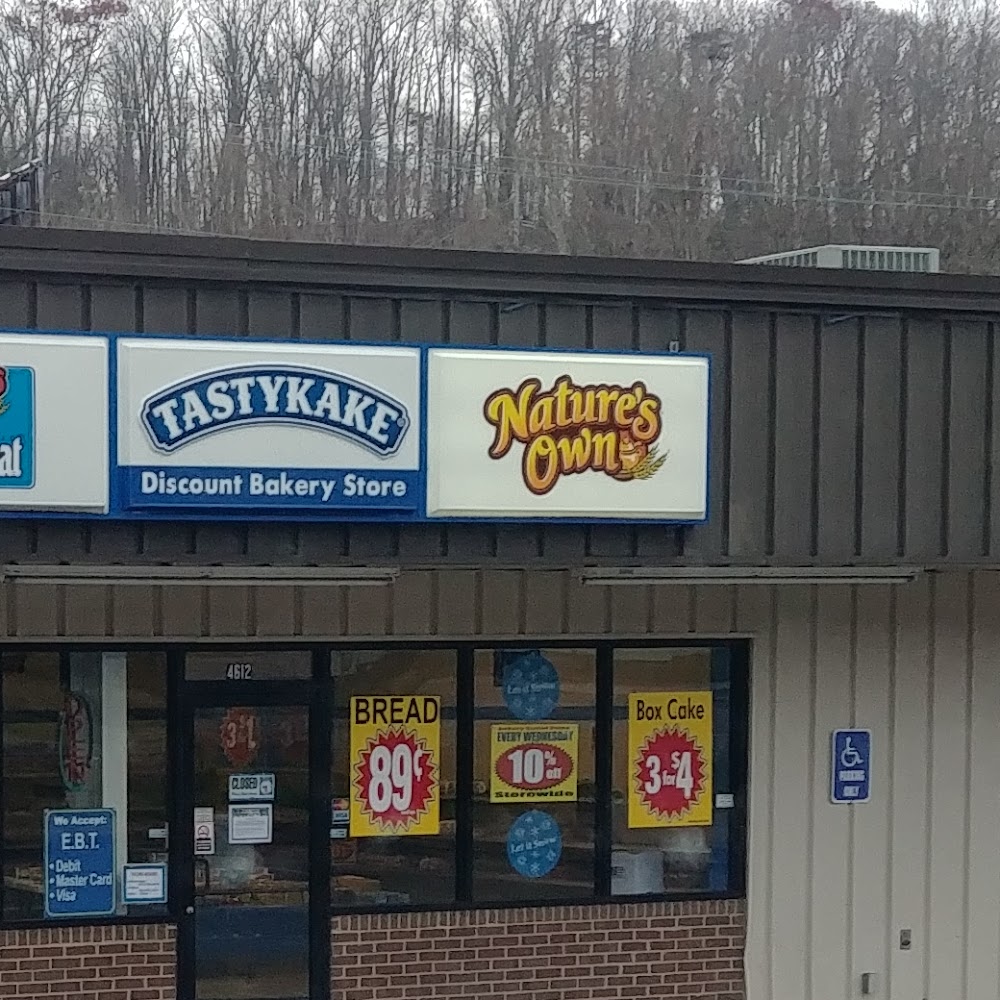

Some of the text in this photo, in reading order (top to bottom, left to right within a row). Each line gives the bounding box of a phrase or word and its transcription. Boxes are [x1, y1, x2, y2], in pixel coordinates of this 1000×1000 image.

[152, 375, 400, 445] TASTYKAKE
[484, 374, 662, 459] Nature's
[522, 428, 620, 495] Own
[141, 471, 407, 502] Discount Bakery Store
[226, 663, 252, 680] 4612
[355, 697, 438, 725] BREAD
[636, 697, 705, 721] Box Cake
[497, 731, 573, 742] EVERY WEDNESDAY
[645, 755, 662, 794] 3
[662, 770, 676, 786] for
[495, 790, 574, 799] Storewide
[53, 816, 69, 826] We
[61, 832, 100, 850] E.B.T.
[55, 859, 81, 872] Debit
[55, 873, 112, 888] Master Card
[56, 890, 77, 901] Visa
